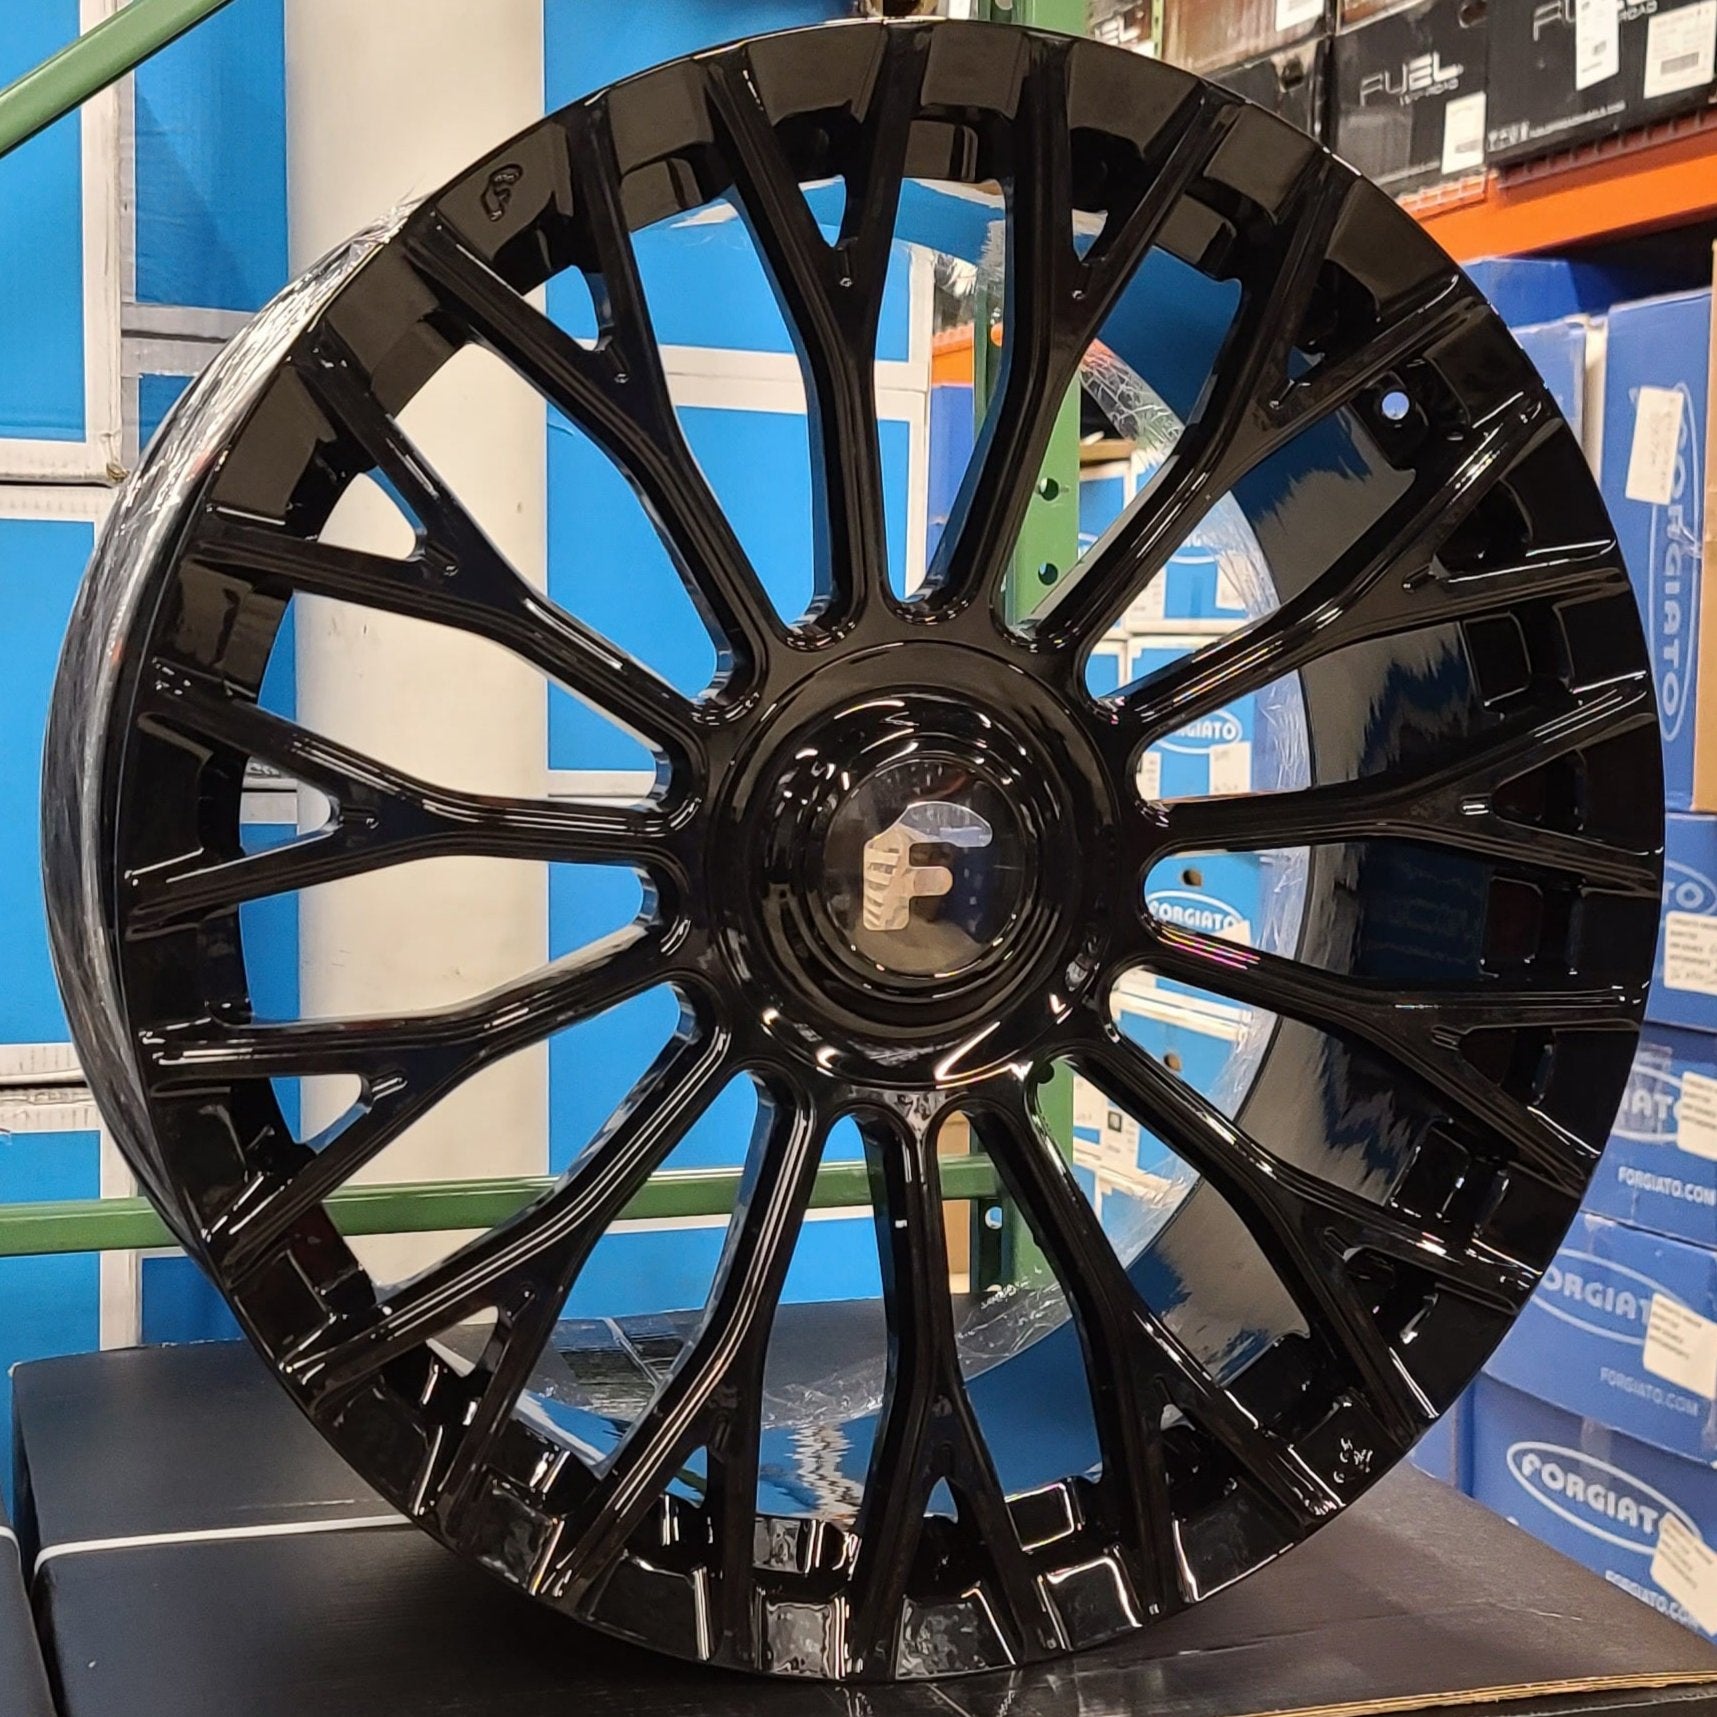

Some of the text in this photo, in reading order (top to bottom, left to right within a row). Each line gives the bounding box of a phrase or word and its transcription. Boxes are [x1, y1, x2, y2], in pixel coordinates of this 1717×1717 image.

[1360, 50, 1464, 107] FUEL
[1662, 420, 1688, 716] ORGIATO
[863, 801, 993, 932] F
[1600, 1366, 1699, 1417] FORGIATO.COM
[1521, 1453, 1660, 1535] FORGIAT
